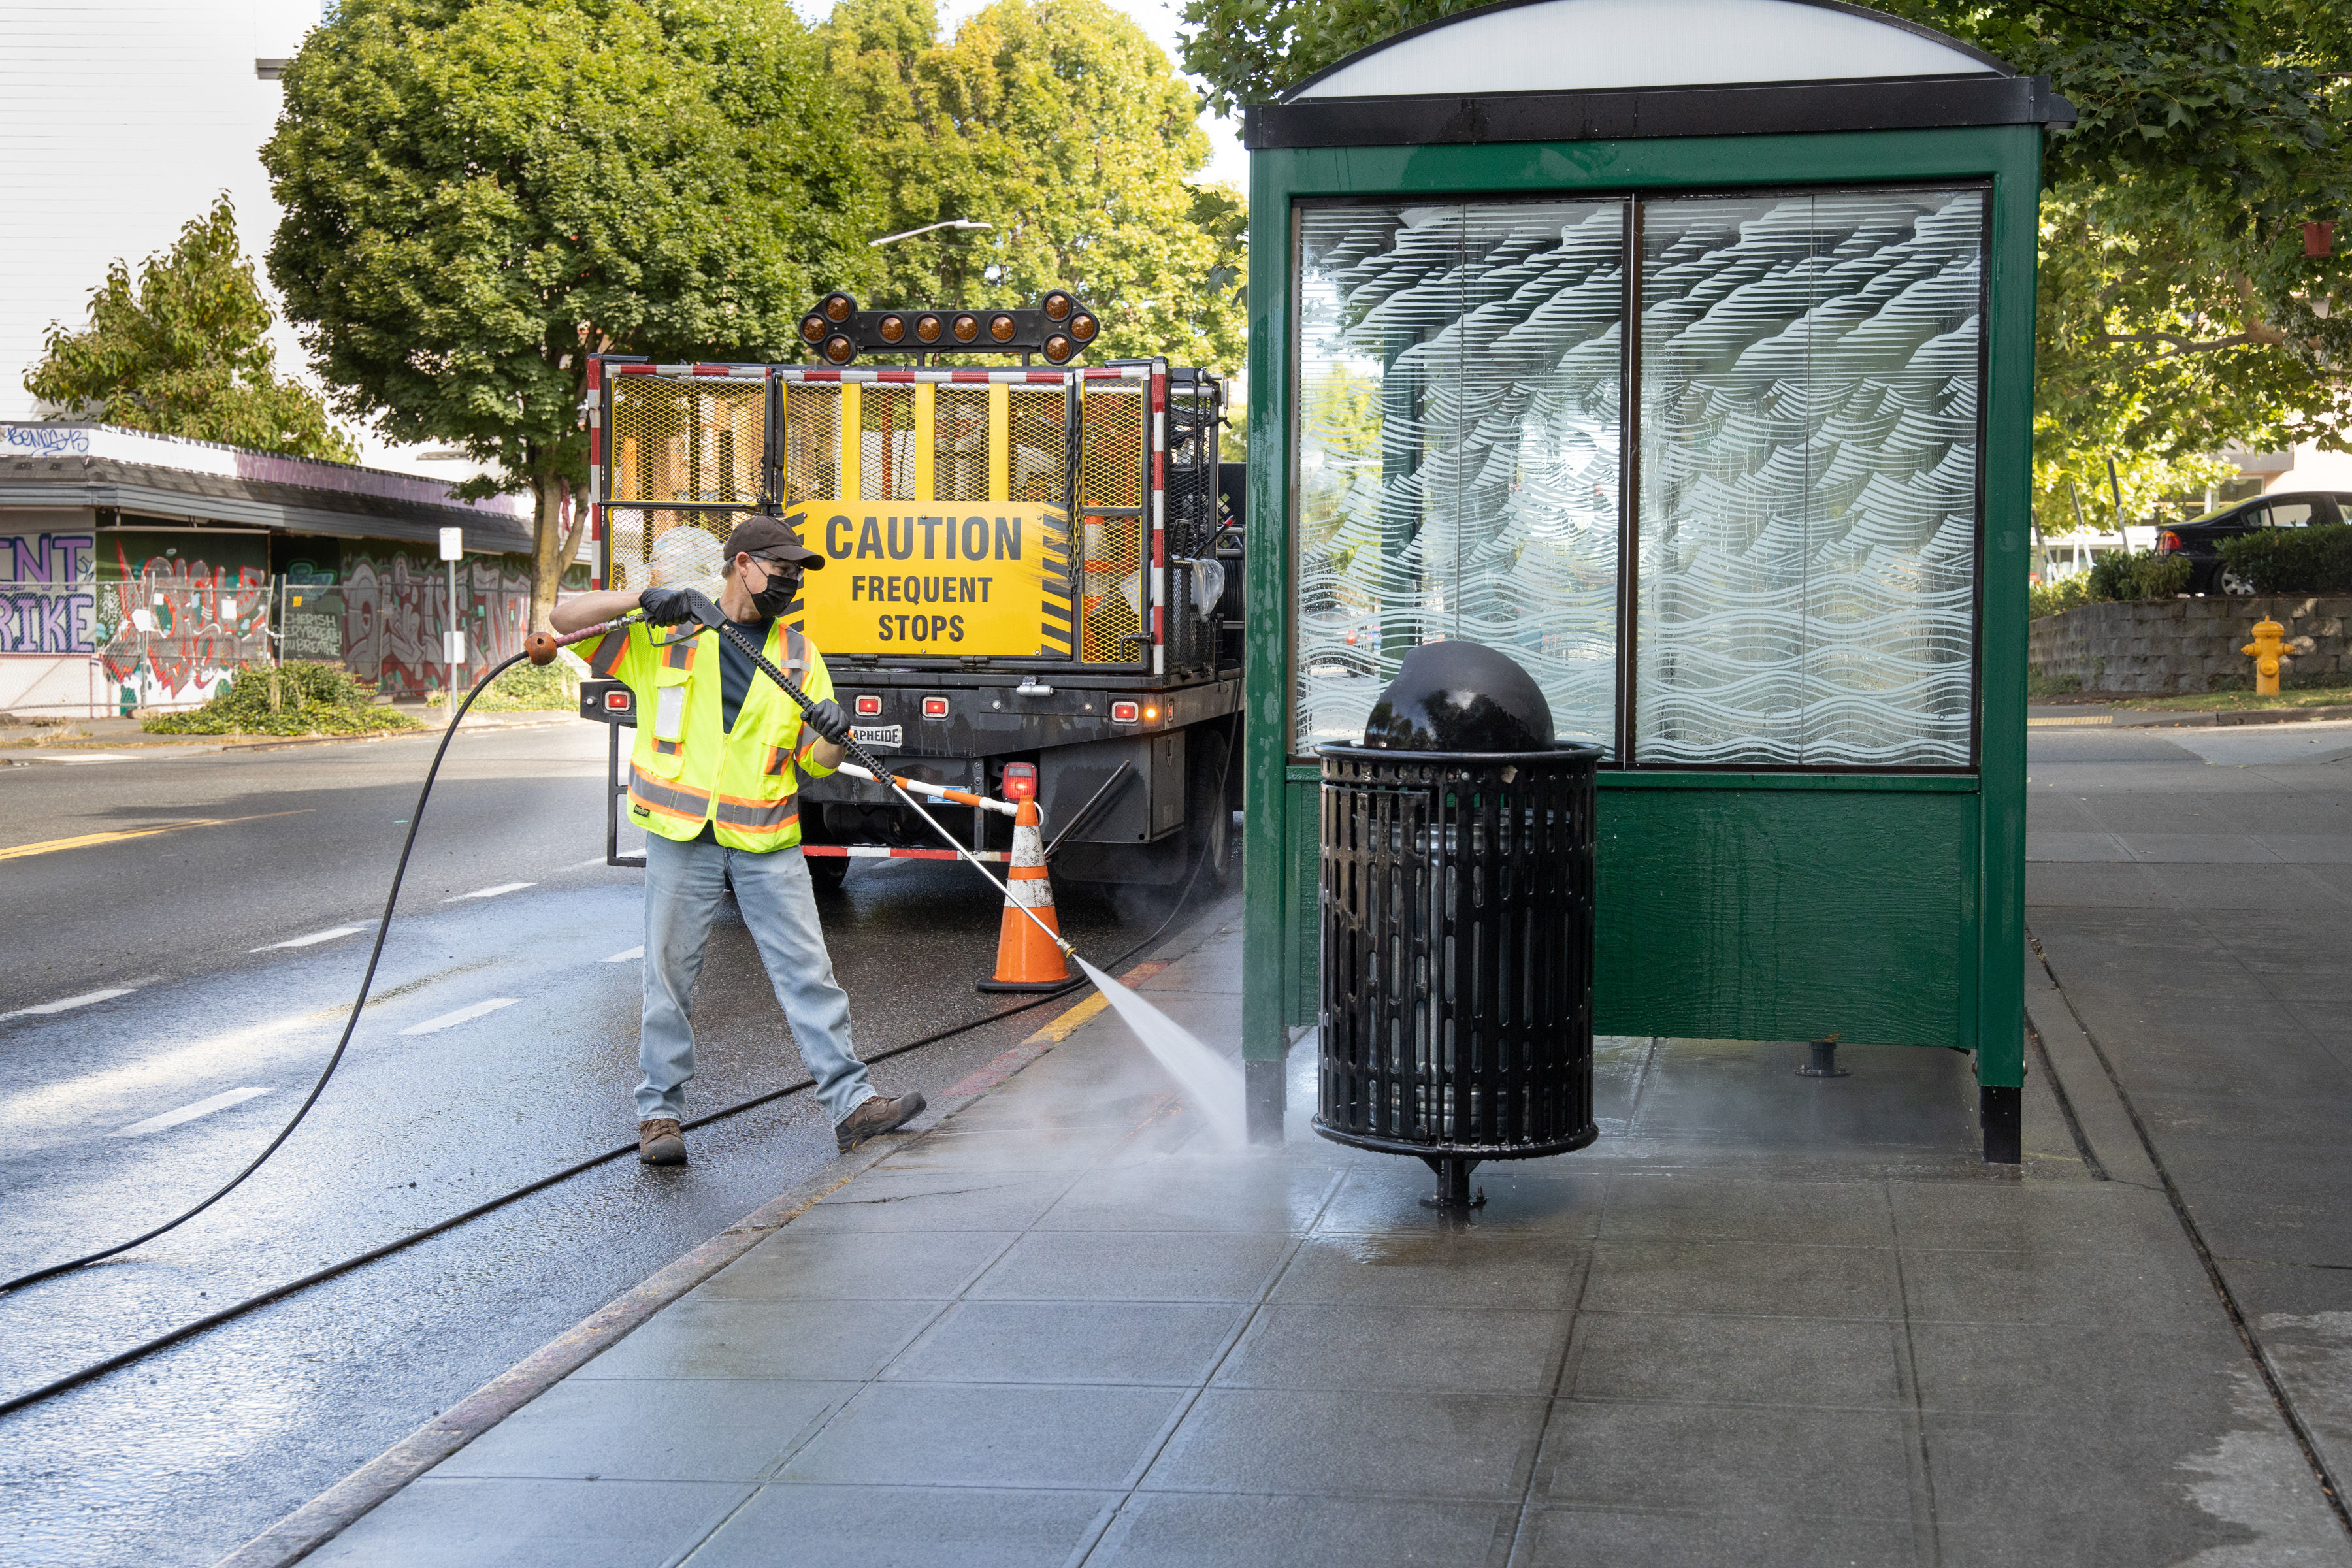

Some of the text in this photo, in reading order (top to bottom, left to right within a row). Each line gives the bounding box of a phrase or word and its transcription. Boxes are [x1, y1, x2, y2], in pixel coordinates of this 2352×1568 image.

[826, 515, 1021, 561] CAUTION
[852, 576, 993, 606] FREQUENT
[284, 613, 336, 627] CHERISH
[879, 614, 964, 642] STOPS
